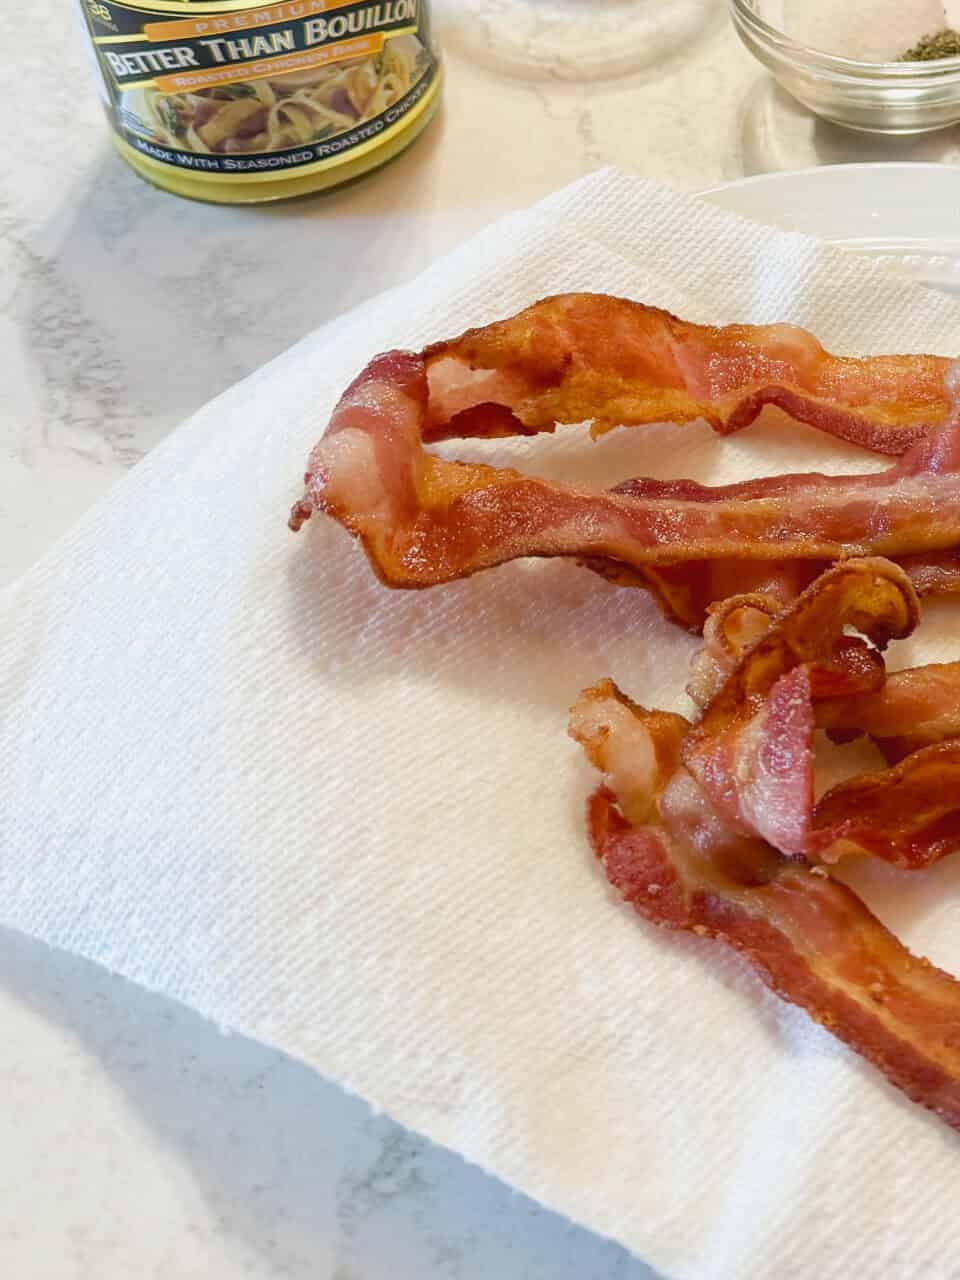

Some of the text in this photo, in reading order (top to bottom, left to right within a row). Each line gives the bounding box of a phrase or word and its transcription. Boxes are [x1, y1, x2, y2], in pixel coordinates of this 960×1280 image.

[195, 0, 326, 32] PREMIUM
[103, 46, 200, 76] BETTER
[198, 29, 296, 63] THAN
[135, 138, 175, 161] MADE
[177, 150, 219, 169] WITH
[222, 150, 314, 170] SEASONED
[317, 121, 385, 157] ROASTED
